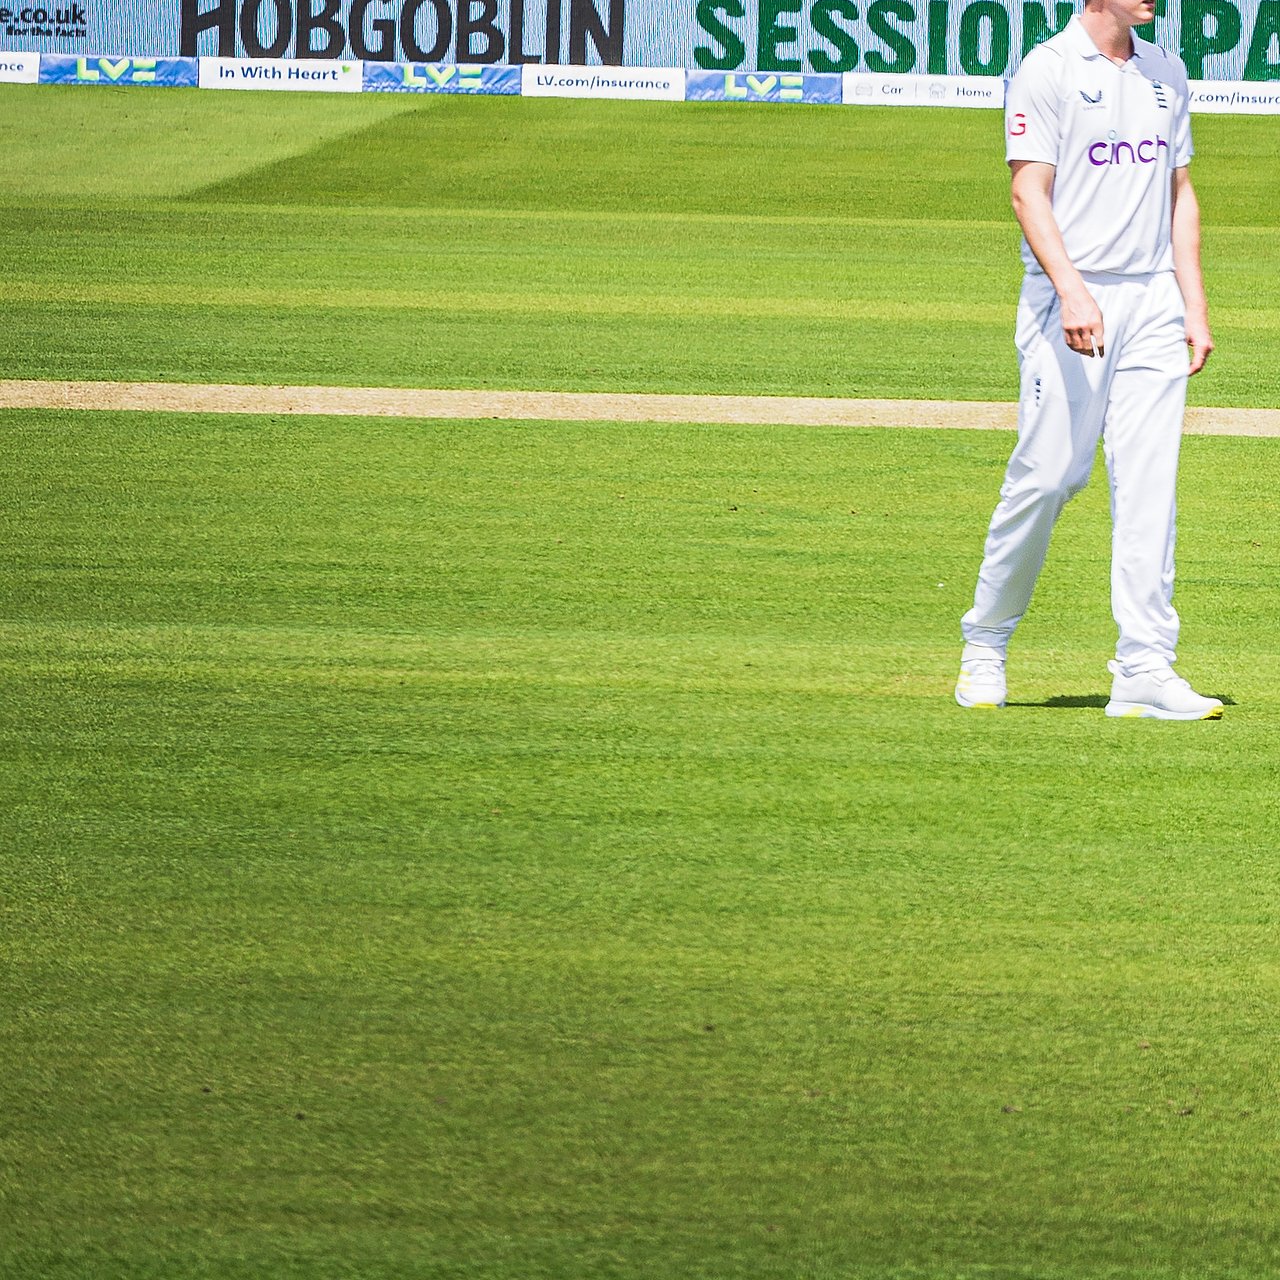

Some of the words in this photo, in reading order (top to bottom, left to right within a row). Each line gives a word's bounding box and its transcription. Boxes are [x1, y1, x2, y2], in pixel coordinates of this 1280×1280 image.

[219, 66, 235, 79] In
[241, 66, 283, 80] With
[288, 67, 339, 81] Heart
[536, 74, 671, 91] LV.com/insurance
[881, 85, 904, 96] Car
[956, 87, 992, 98] Home
